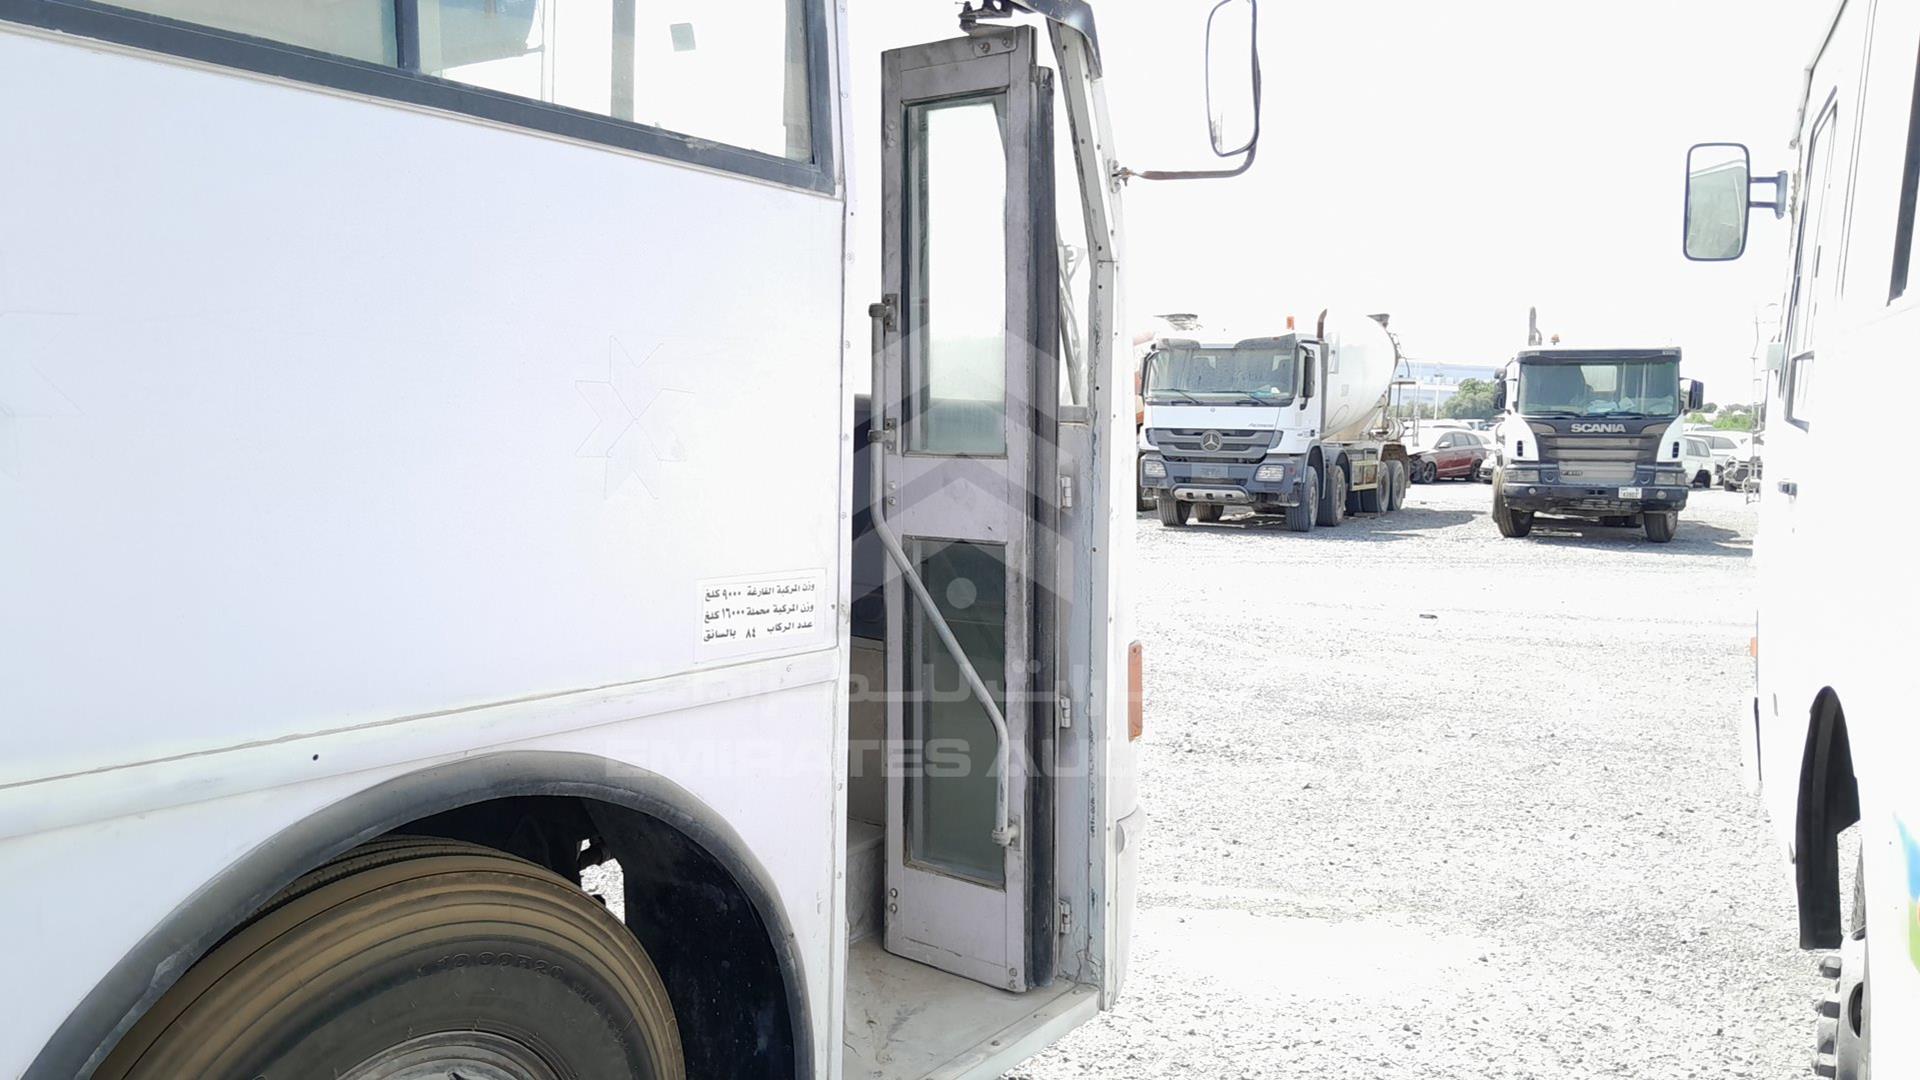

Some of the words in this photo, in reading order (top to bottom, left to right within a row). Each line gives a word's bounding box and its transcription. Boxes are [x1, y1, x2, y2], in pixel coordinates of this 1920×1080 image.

[1570, 423, 1626, 433] SCANIA
[746, 585, 775, 597] الفارغة
[777, 583, 801, 598] المركبة
[801, 581, 815, 592] وزن
[704, 589, 720, 602] كلغ
[746, 606, 770, 617] محملة
[772, 603, 799, 615] المركبة
[800, 602, 814, 613] وزن
[703, 610, 720, 623] كلغ
[766, 622, 795, 634] الركاب
[796, 621, 813, 630] عدد
[703, 629, 737, 642] بالسائق
[745, 628, 757, 639] ٨٤
